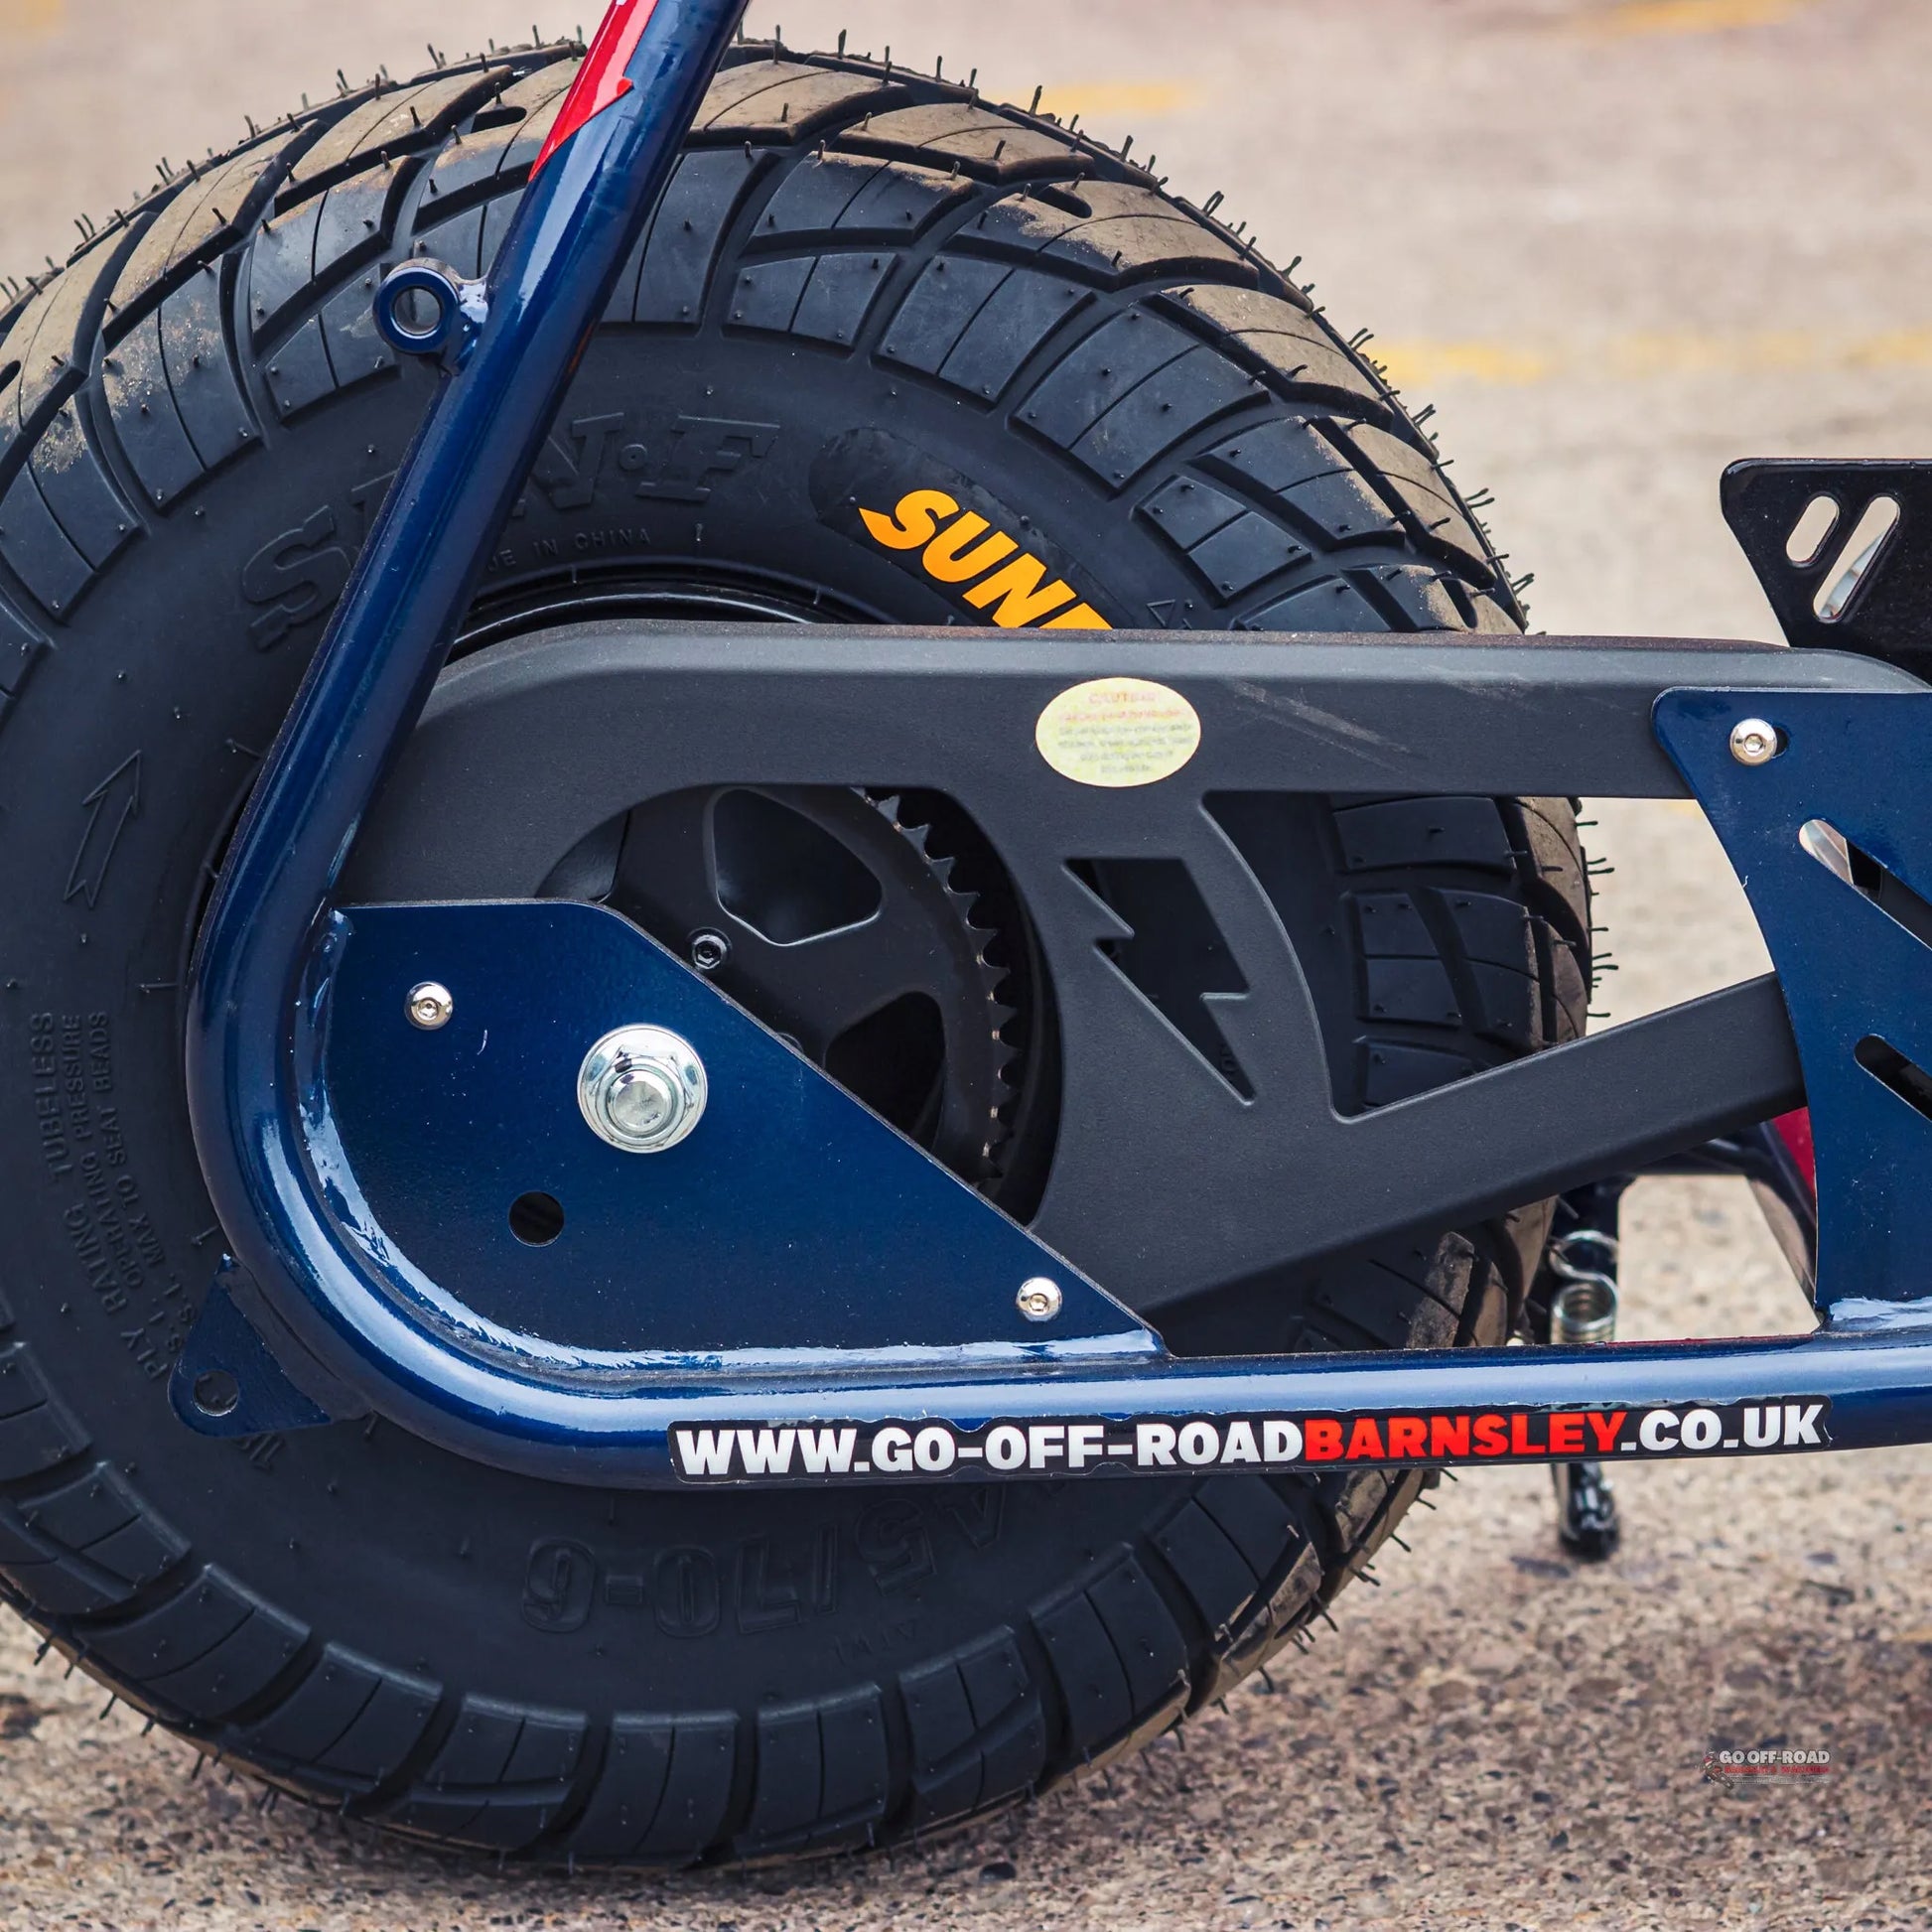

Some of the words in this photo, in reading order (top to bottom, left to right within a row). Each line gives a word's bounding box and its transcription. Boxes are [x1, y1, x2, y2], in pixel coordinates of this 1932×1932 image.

[533, 537, 559, 556] IN
[574, 527, 652, 551] CHINA
[858, 488, 1113, 630] SUN
[62, 1014, 93, 1141] PRESSURE
[87, 1011, 113, 1091] BEADS
[30, 1011, 73, 1183] TUBELESS
[96, 1105, 127, 1166] SEAT
[80, 1151, 144, 1287] OPERATING
[116, 1174, 139, 1210] TO
[64, 1202, 127, 1313] RATING
[129, 1211, 167, 1265] MAX
[120, 1327, 169, 1379] PLY
[675, 1404, 1826, 1475] WWW.GO-OFF-ROADBARNSLEY.CO.UK
